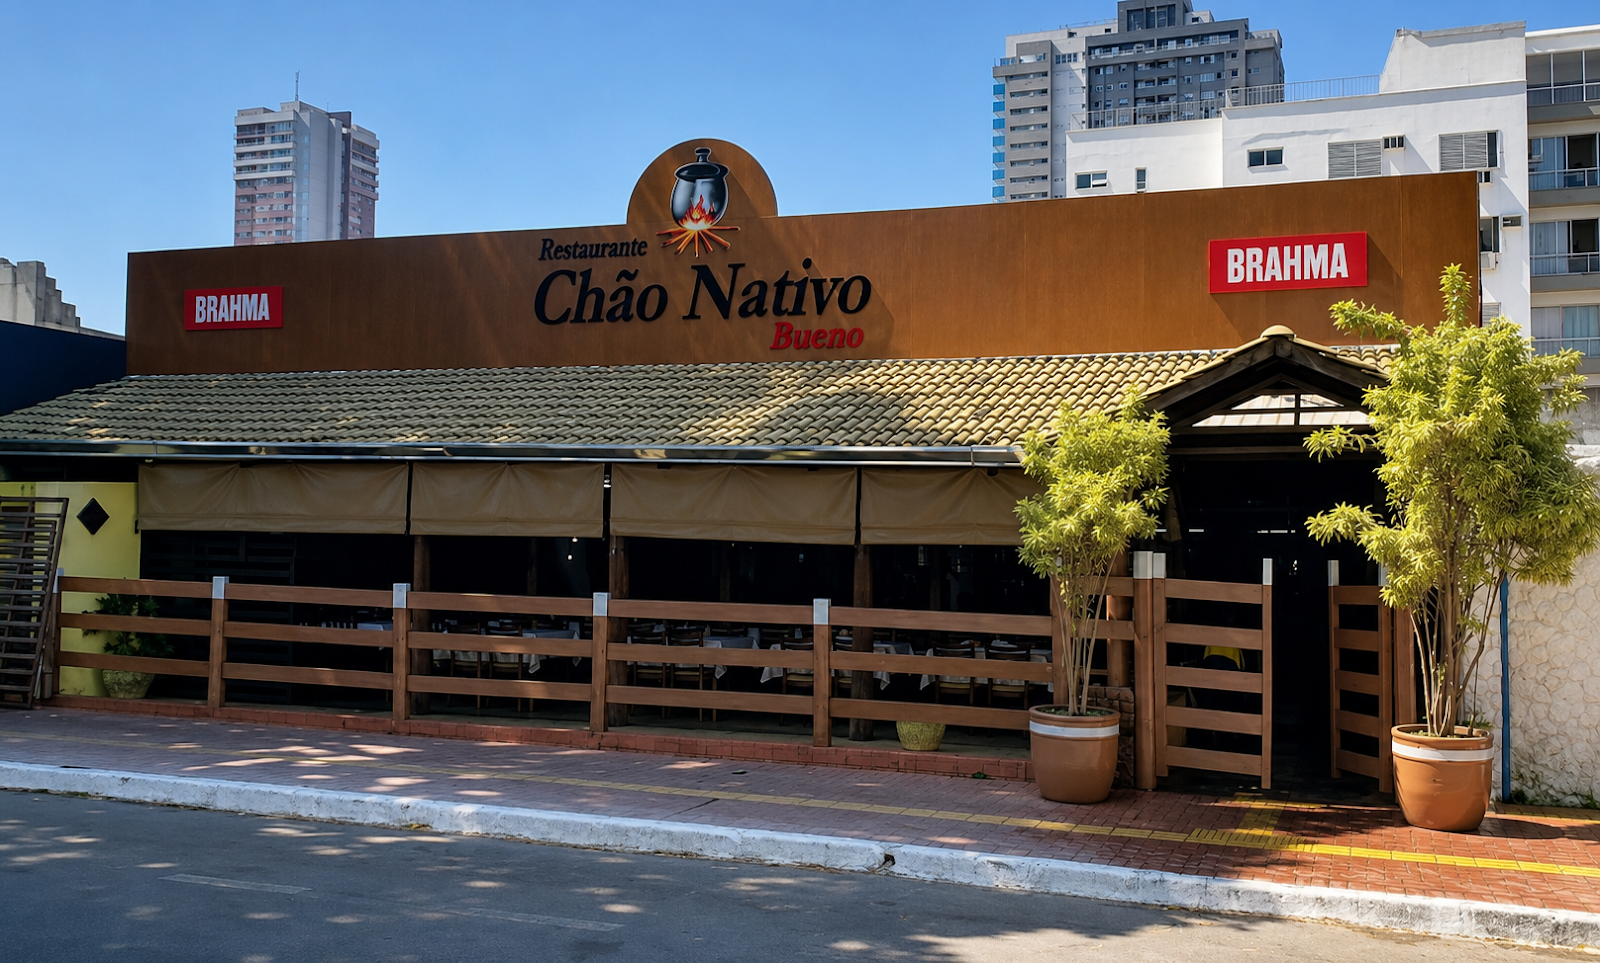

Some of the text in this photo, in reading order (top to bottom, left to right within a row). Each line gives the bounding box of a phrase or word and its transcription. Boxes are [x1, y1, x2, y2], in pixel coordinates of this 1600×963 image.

[538, 237, 647, 261] Restaurante
[1227, 242, 1349, 284] BRAHMA
[534, 257, 872, 325] Chão Nativo
[195, 293, 270, 323] BRAHMA
[769, 321, 864, 350] Bueno
